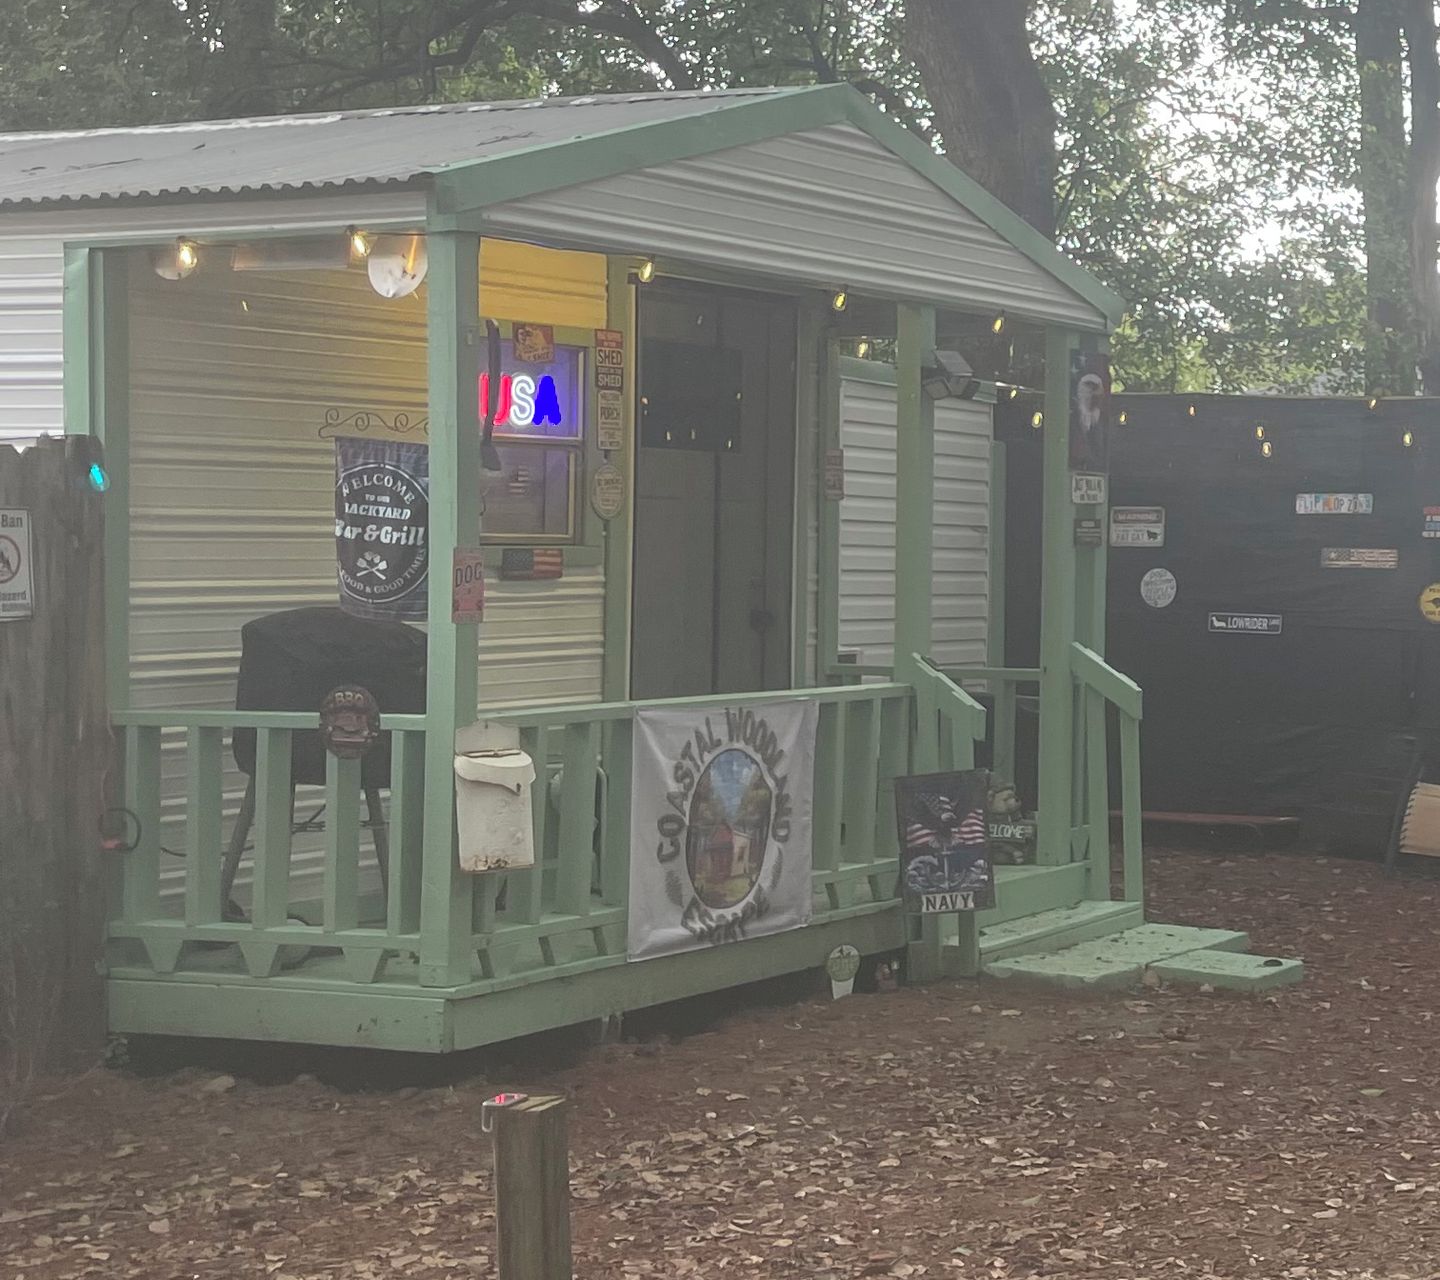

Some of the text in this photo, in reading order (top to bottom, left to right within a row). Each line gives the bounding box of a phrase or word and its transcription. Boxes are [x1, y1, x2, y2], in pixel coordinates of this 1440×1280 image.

[598, 348, 622, 365] SHED
[598, 373, 621, 387] SHED
[478, 371, 562, 426] USA
[1, 514, 23, 528] Ban
[363, 524, 380, 541] &
[380, 525, 425, 546] Grill
[455, 562, 482, 588] DOG
[374, 577, 404, 594] GOOD
[1227, 616, 1268, 630] LOWRIDER
[657, 716, 722, 864] COASTAL
[925, 893, 973, 911] NAVY
